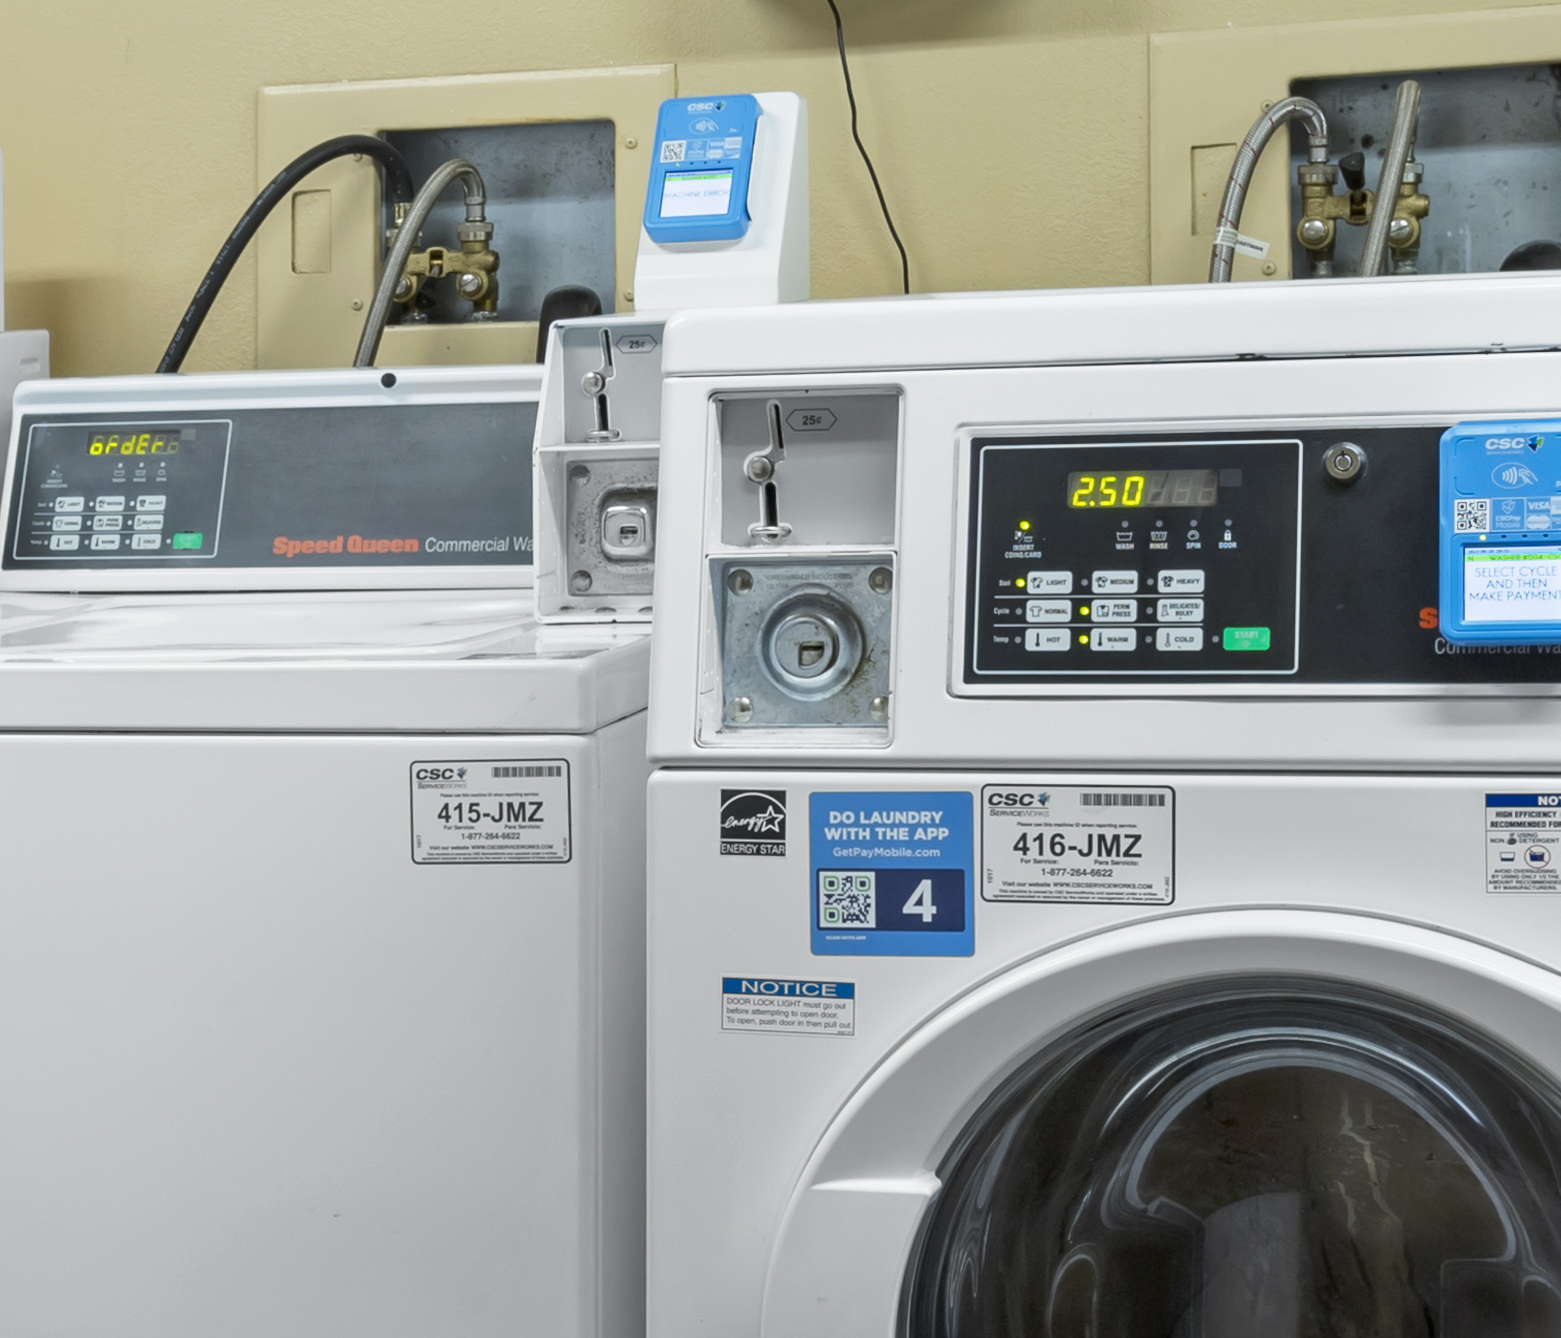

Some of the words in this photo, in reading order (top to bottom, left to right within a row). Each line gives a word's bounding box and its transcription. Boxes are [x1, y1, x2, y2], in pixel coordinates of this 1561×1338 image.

[802, 415, 822, 426] 25¢
[1485, 438, 1525, 450] CSC
[1072, 476, 1144, 506] 2.50
[1528, 502, 1550, 510] VISA
[273, 536, 344, 558] Speed
[347, 535, 420, 554] Queen
[425, 536, 509, 553] Commercial
[1475, 566, 1515, 577] SELECT
[1519, 565, 1557, 577] CYCLE
[1486, 579, 1513, 589] AND
[1517, 578, 1547, 588] THEN
[1469, 591, 1503, 602] MAKE
[1234, 631, 1259, 639] START
[416, 768, 454, 780] CSC
[988, 793, 1034, 806] CSC
[437, 801, 544, 823] 415-JMZ
[829, 811, 855, 824] DO
[860, 811, 943, 824] LAUNDRY
[824, 828, 870, 841] WITH
[875, 828, 909, 841] THE
[914, 828, 949, 841] APP
[721, 843, 759, 854] ENERGY
[760, 844, 785, 855] STAR
[1013, 832, 1142, 858] 416-JMZ
[833, 847, 940, 858] GetPayMobile.com
[1041, 868, 1113, 877] 1-877-264-6622
[902, 879, 937, 923] 4
[742, 980, 837, 997] NOTICE
[727, 997, 751, 1005] DOOR
[753, 999, 776, 1007] LOCK
[777, 1000, 802, 1008] LIGHT
[726, 1007, 750, 1015] before
[751, 1009, 790, 1018] attempting
[800, 1011, 819, 1019] open
[821, 1011, 838, 1019] door.
